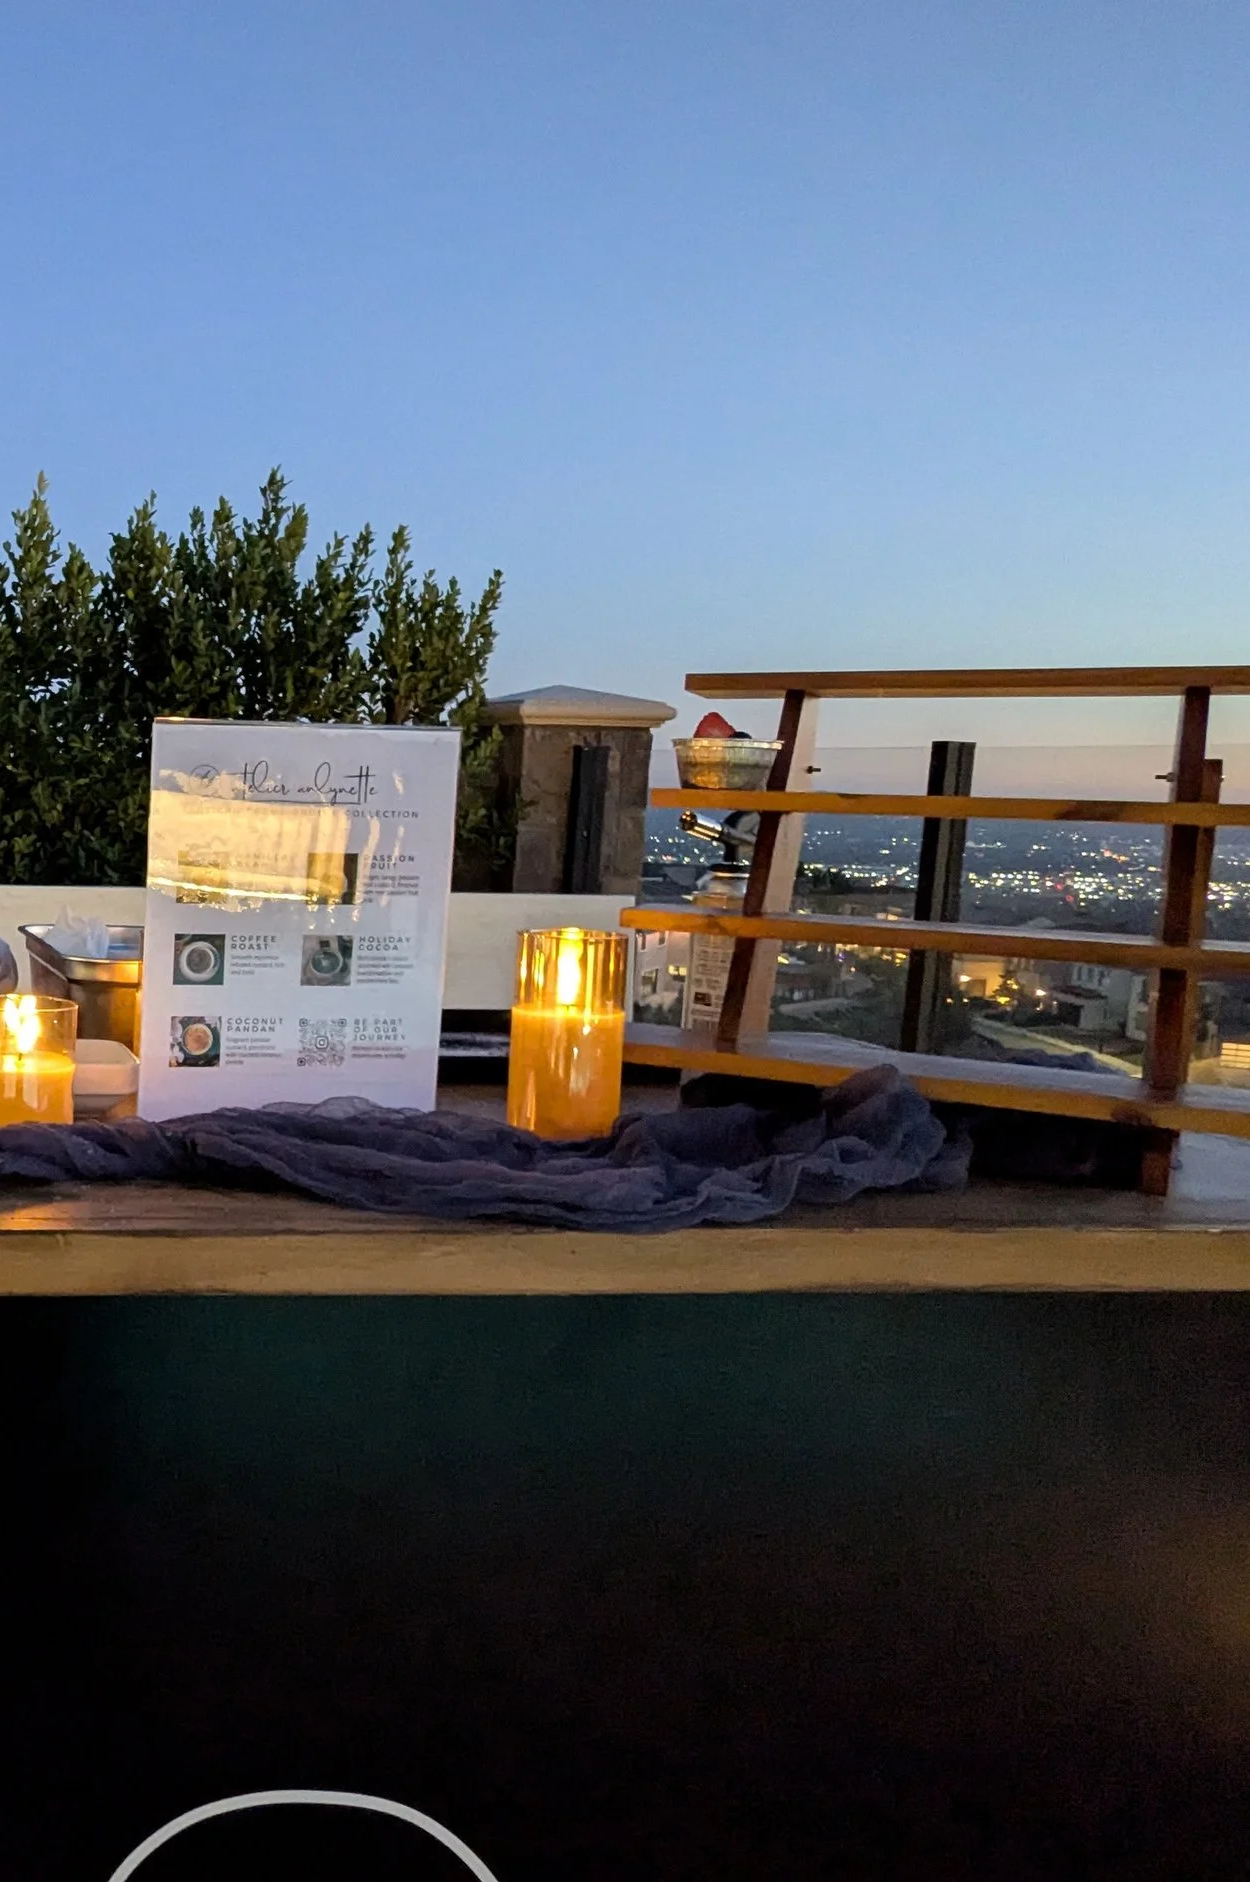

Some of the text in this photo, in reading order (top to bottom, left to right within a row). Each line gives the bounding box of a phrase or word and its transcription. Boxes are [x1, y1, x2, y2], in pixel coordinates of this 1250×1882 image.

[345, 810, 419, 819] COLLECTION
[231, 935, 278, 943] COFFEE
[359, 936, 411, 944] HOLIDAY
[230, 943, 269, 951] ROAST
[226, 1017, 283, 1025] COCONUT
[226, 1025, 276, 1033] PANDAN
[374, 1026, 398, 1034] OUR
[353, 1033, 406, 1041] JOURNEY
